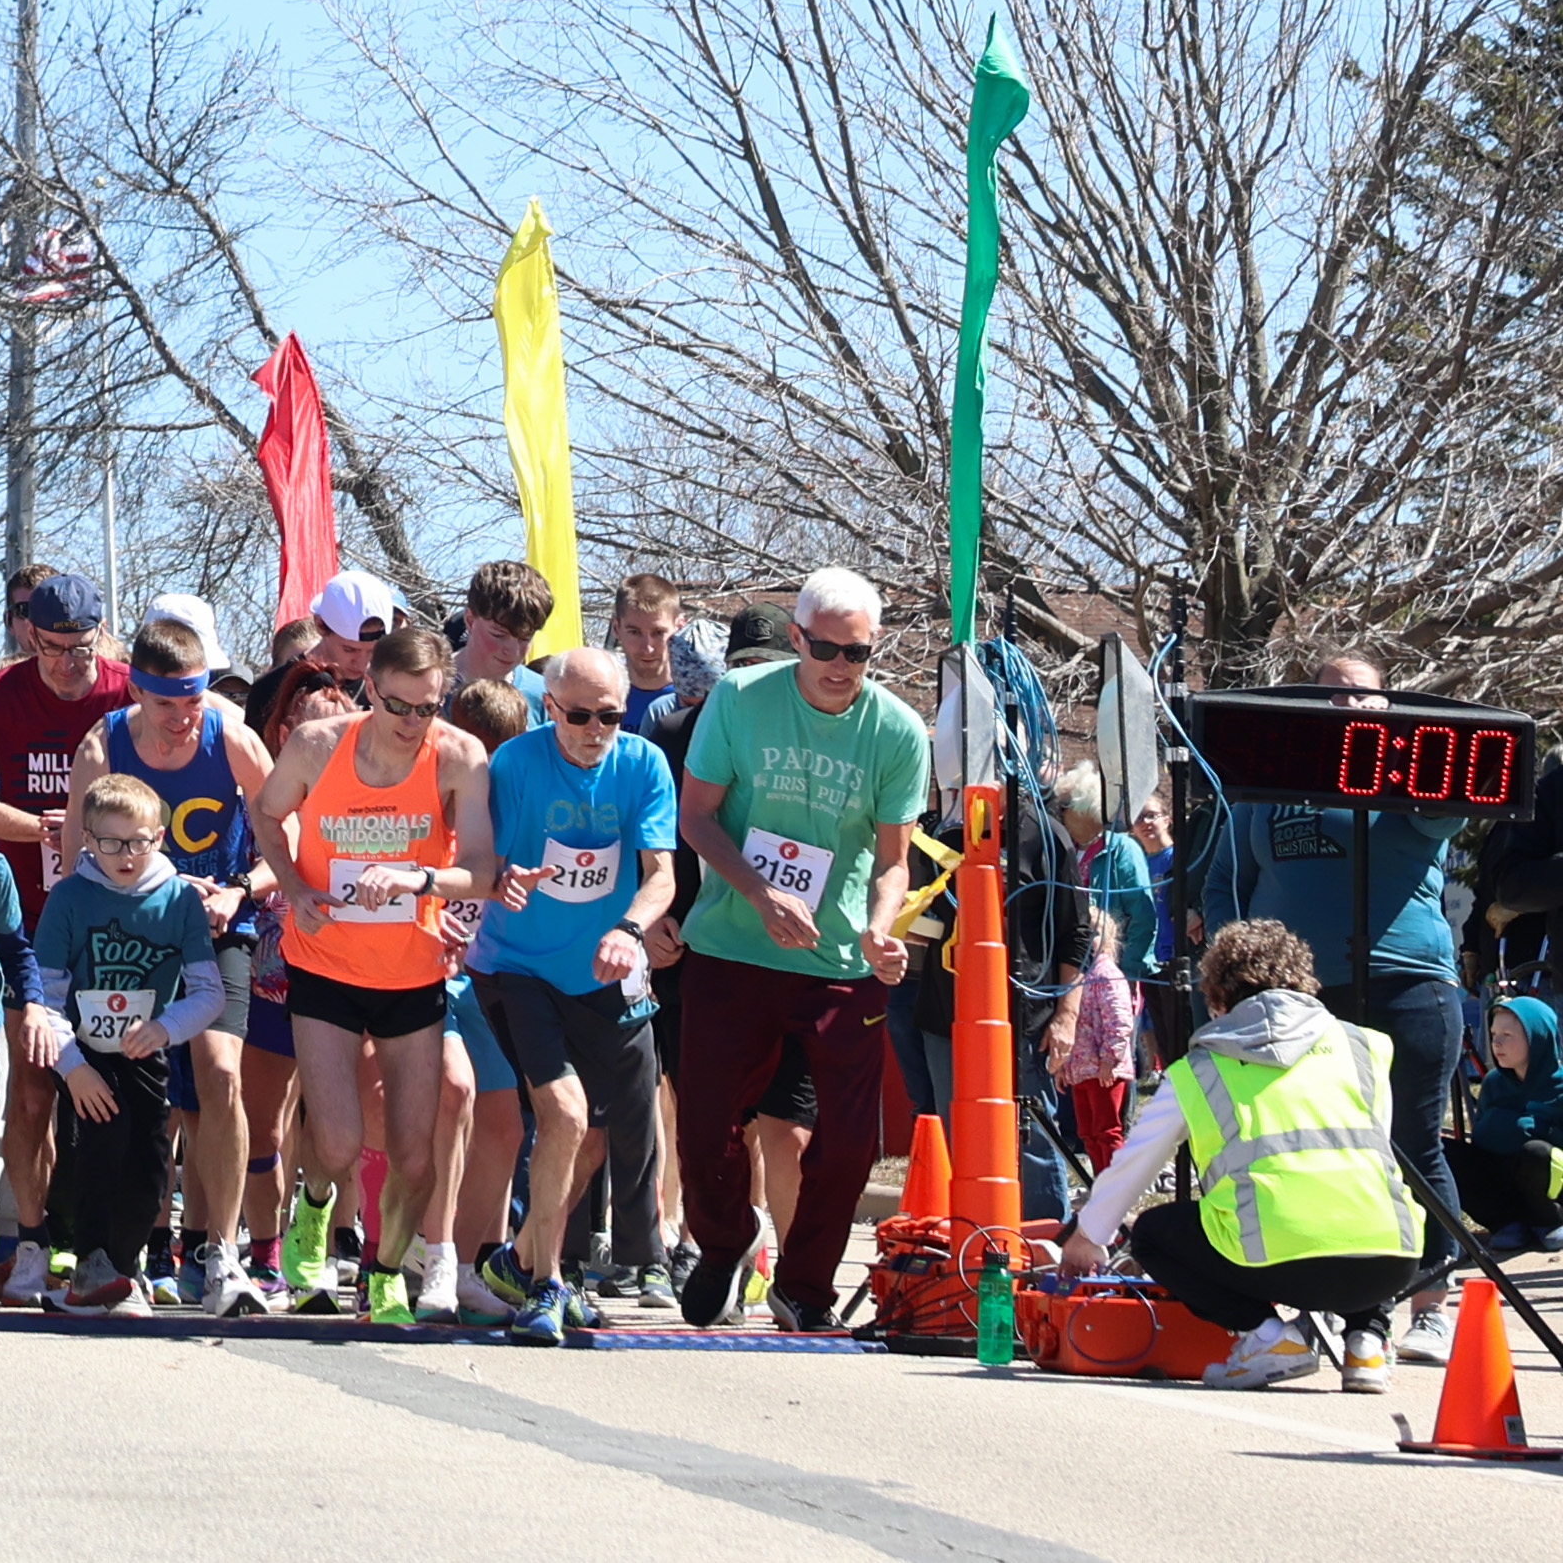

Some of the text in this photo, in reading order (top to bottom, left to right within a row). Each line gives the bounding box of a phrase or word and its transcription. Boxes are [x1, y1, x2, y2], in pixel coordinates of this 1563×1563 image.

[1338, 721, 1516, 803] 0:00
[773, 775, 809, 792] IRIS
[320, 813, 432, 831] NATIONALS
[547, 800, 619, 833] one
[330, 829, 410, 843] INDOOR
[551, 864, 608, 888] 2188
[753, 854, 812, 892] 2158
[92, 932, 175, 970] FOOLS
[1310, 1045, 1333, 1055] EW
